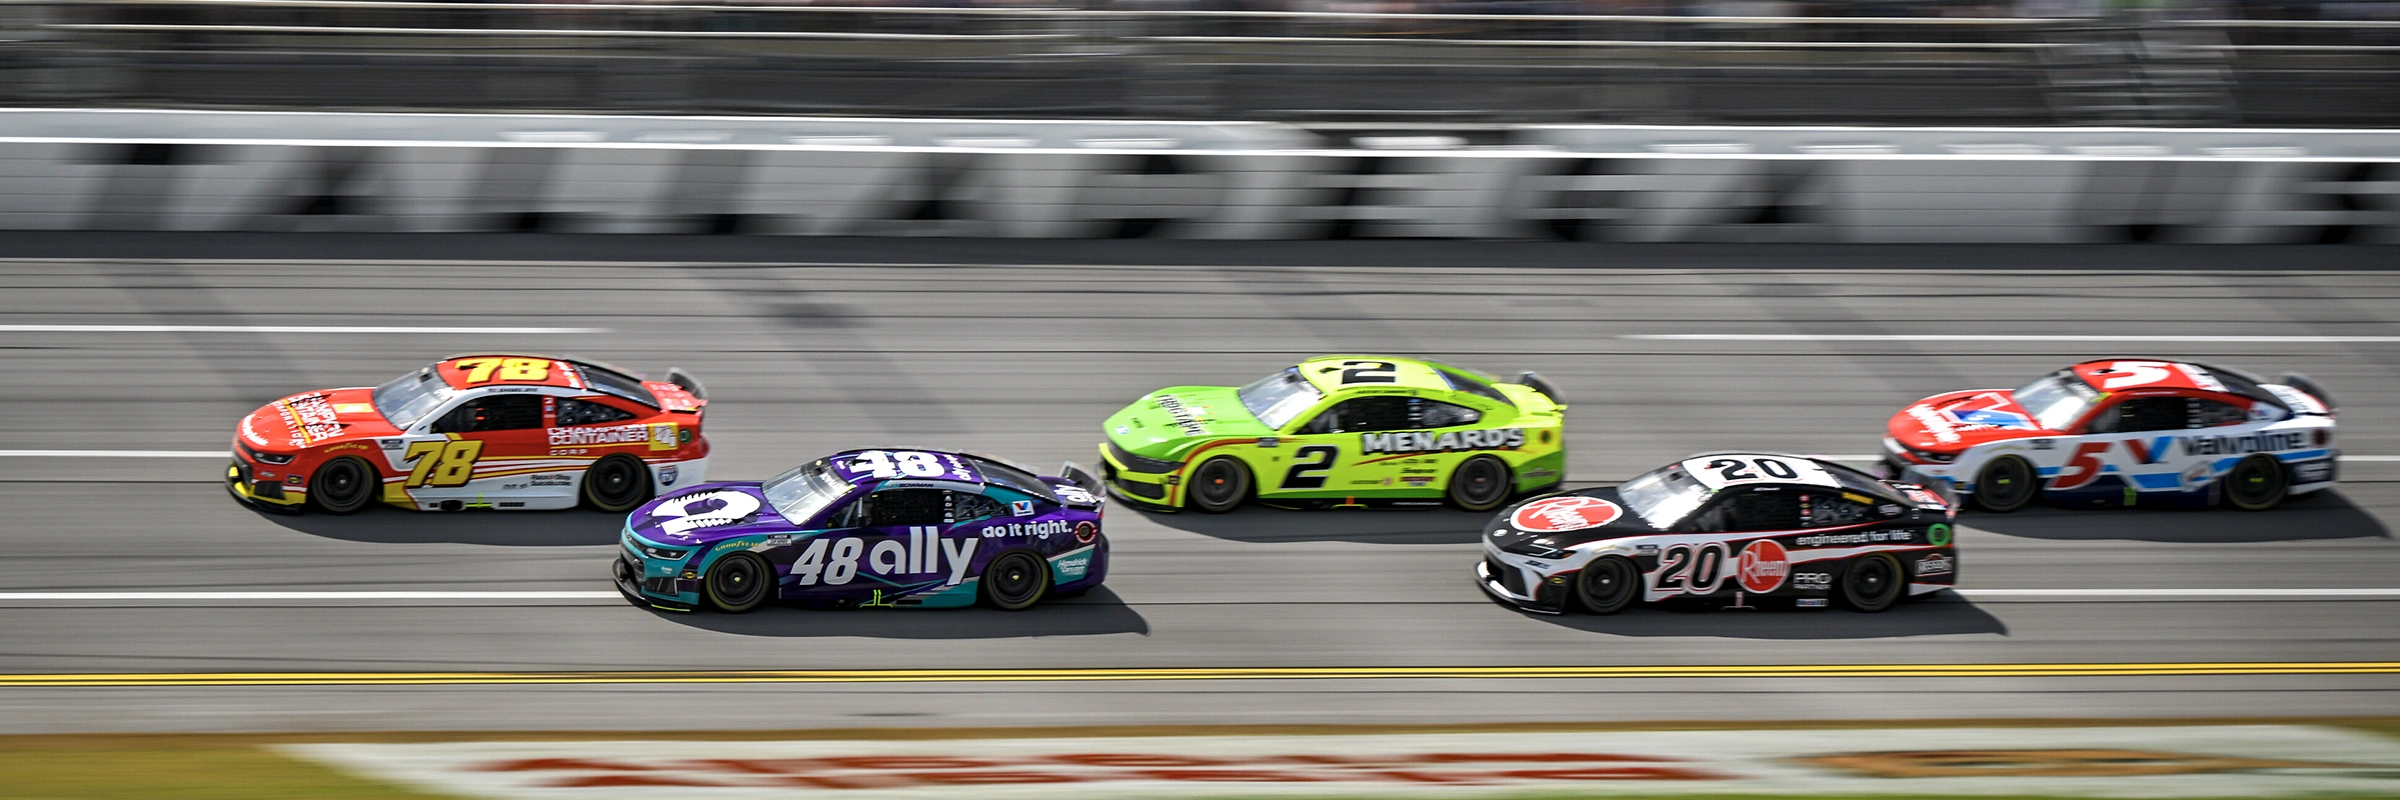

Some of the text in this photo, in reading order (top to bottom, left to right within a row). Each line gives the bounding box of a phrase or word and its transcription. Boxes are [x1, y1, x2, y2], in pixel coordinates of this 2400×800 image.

[455, 357, 550, 383] 78
[1341, 361, 1396, 384] 2
[2103, 361, 2171, 389] 5
[547, 424, 648, 436] CHAMPION
[549, 431, 649, 445] CONTAINER
[1362, 428, 1525, 455] MENARDS
[2179, 431, 2305, 456] Valvoline
[403, 440, 484, 487] 78
[850, 450, 945, 478] 48
[1278, 445, 1339, 489] 2
[1709, 459, 1798, 480] 20
[2052, 442, 2114, 489] 5
[982, 520, 1073, 539] do it right.
[1796, 530, 1912, 546] engineered for life
[790, 537, 864, 586] 48
[869, 526, 979, 586] ally
[1058, 558, 1087, 569] Hendrick
[1653, 542, 1730, 595] 20
[1740, 542, 1786, 584] Rheem
[1794, 573, 1832, 584] PRO
